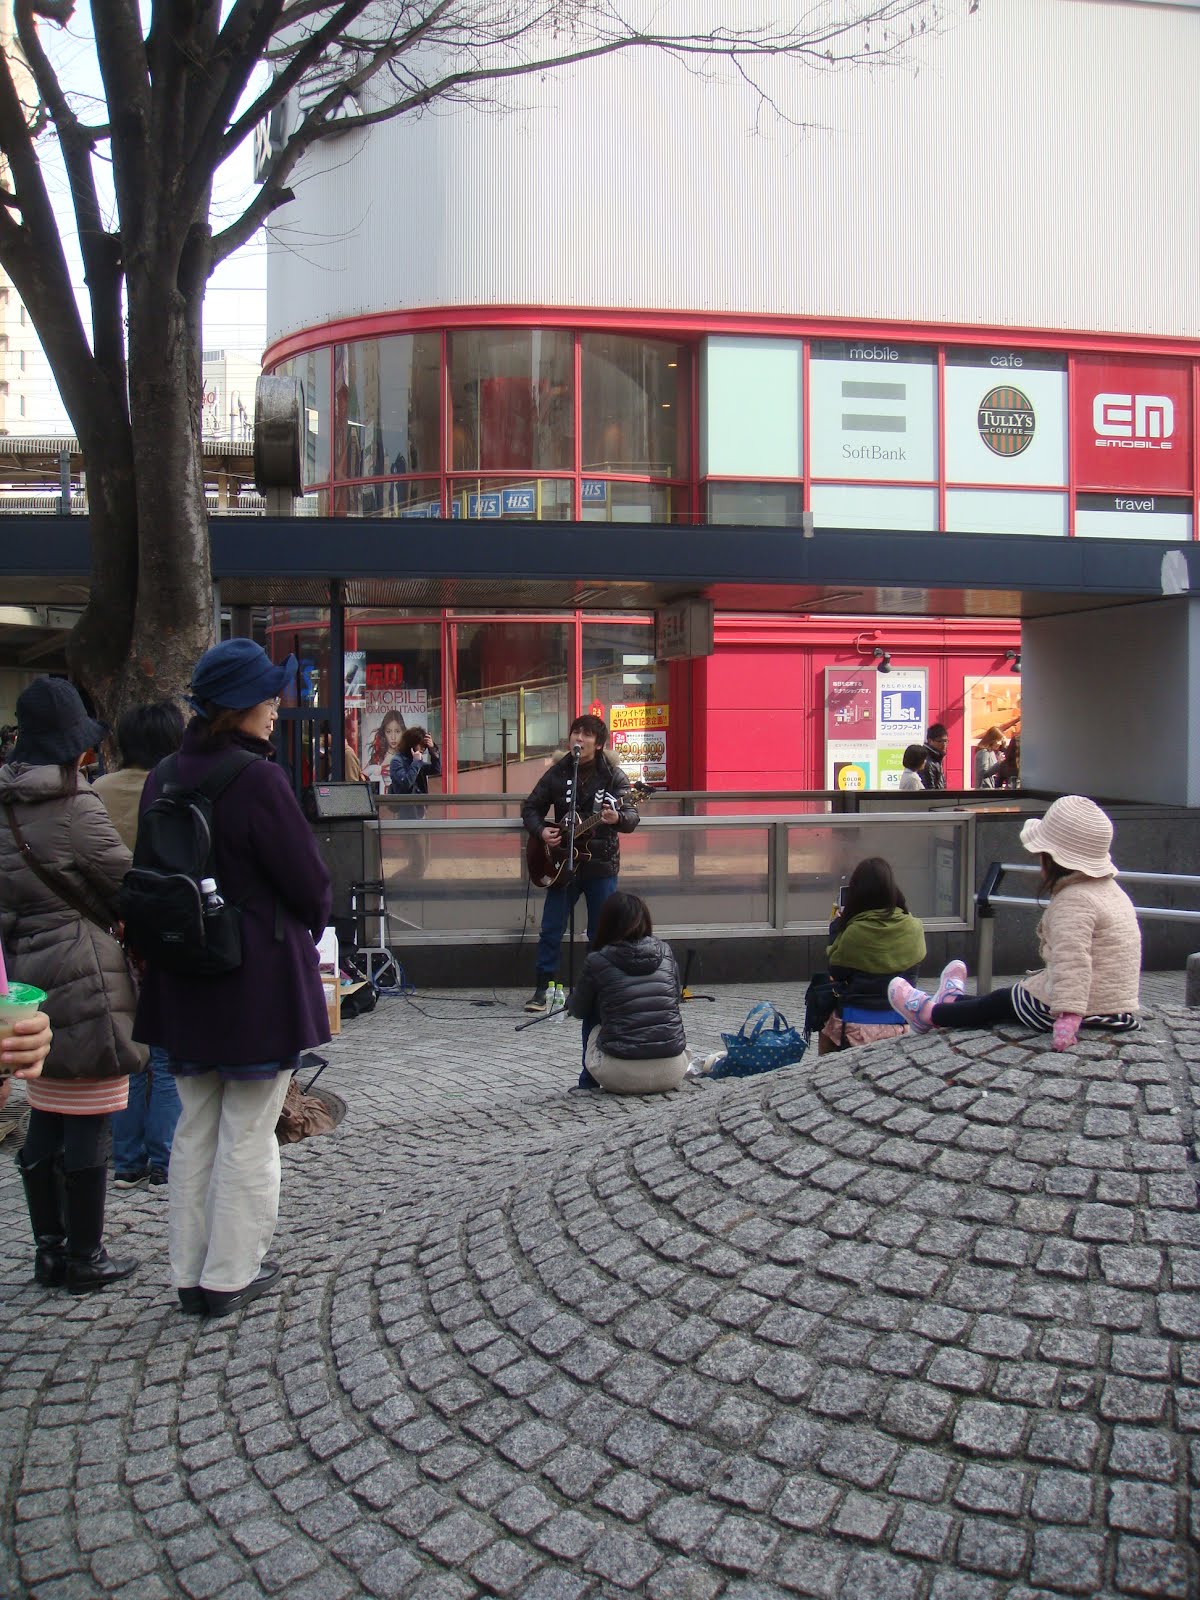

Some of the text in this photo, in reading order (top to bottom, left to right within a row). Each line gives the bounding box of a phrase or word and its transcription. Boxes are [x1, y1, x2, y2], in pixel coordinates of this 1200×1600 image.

[850, 346, 899, 361] mobile
[990, 353, 1023, 367] cafe
[989, 427, 1024, 435] COFFEE
[1095, 439, 1173, 450] EMOBILE
[842, 444, 907, 460] SoftBank
[1114, 497, 1154, 511] travel
